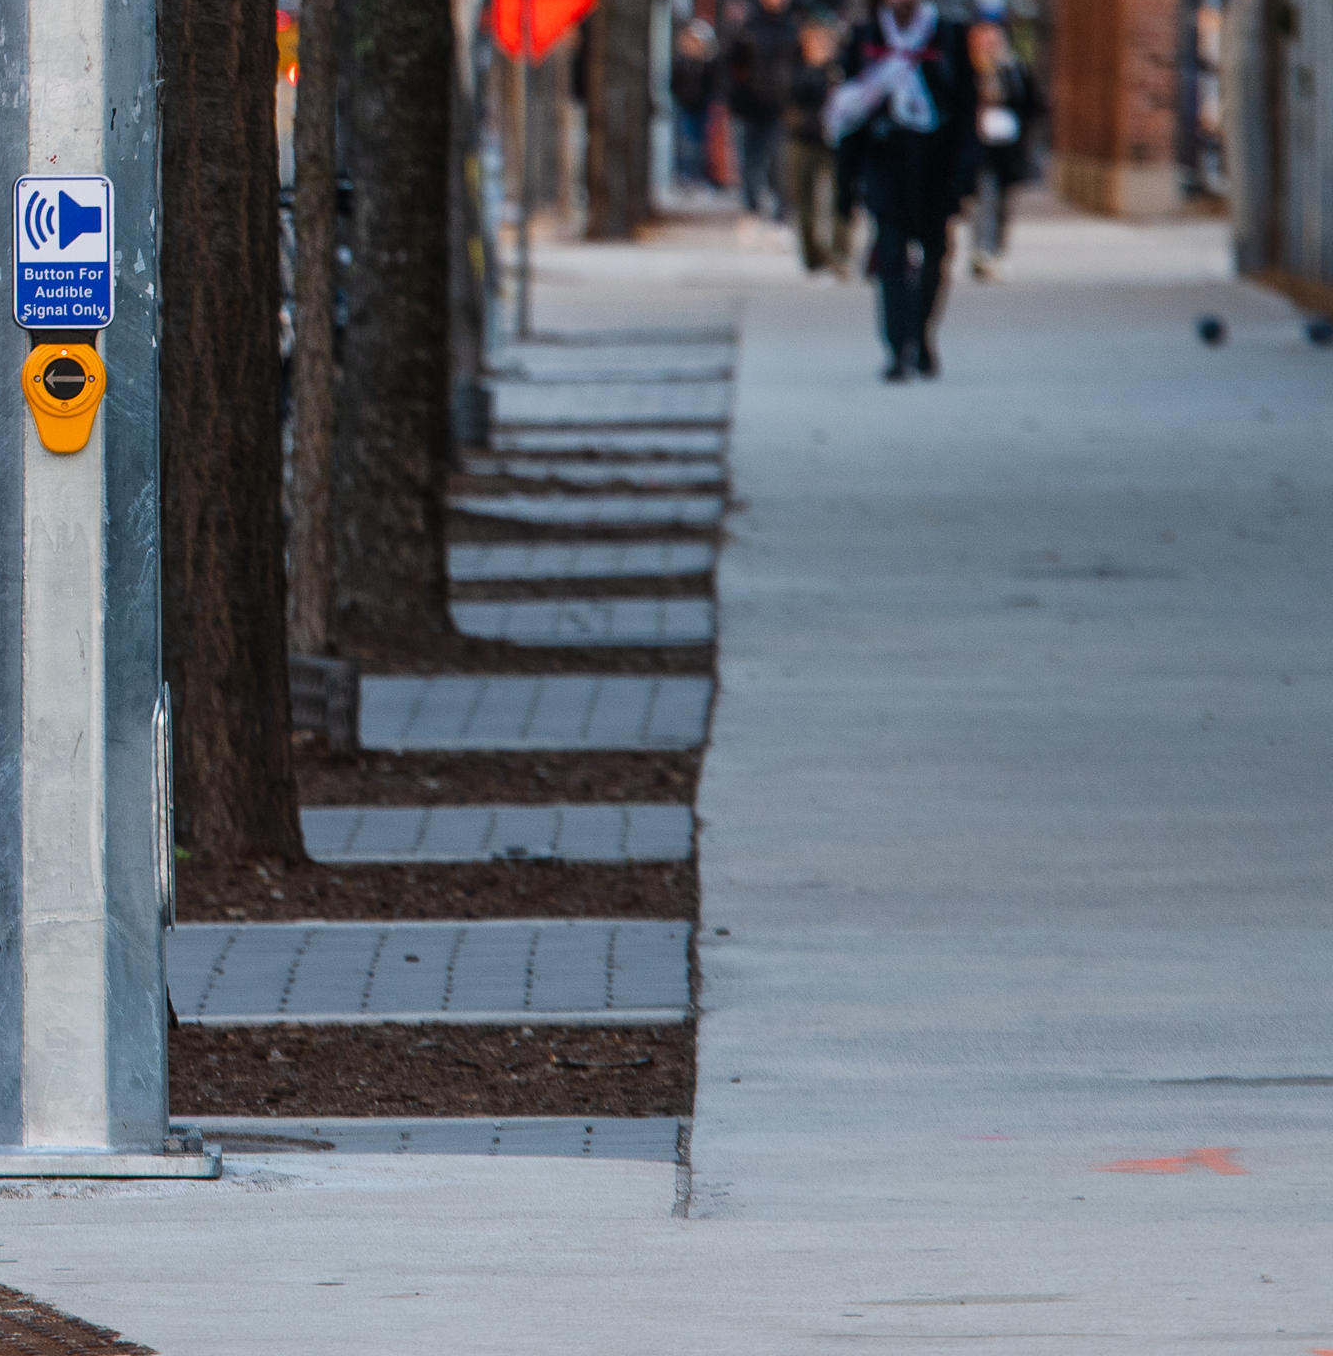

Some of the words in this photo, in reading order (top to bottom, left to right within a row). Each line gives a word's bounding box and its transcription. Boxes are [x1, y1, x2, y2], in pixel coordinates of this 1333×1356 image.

[24, 268, 74, 280] Button
[79, 268, 104, 280] For
[34, 285, 93, 298] Audible
[23, 303, 68, 319] Signal
[72, 303, 105, 319] Only
